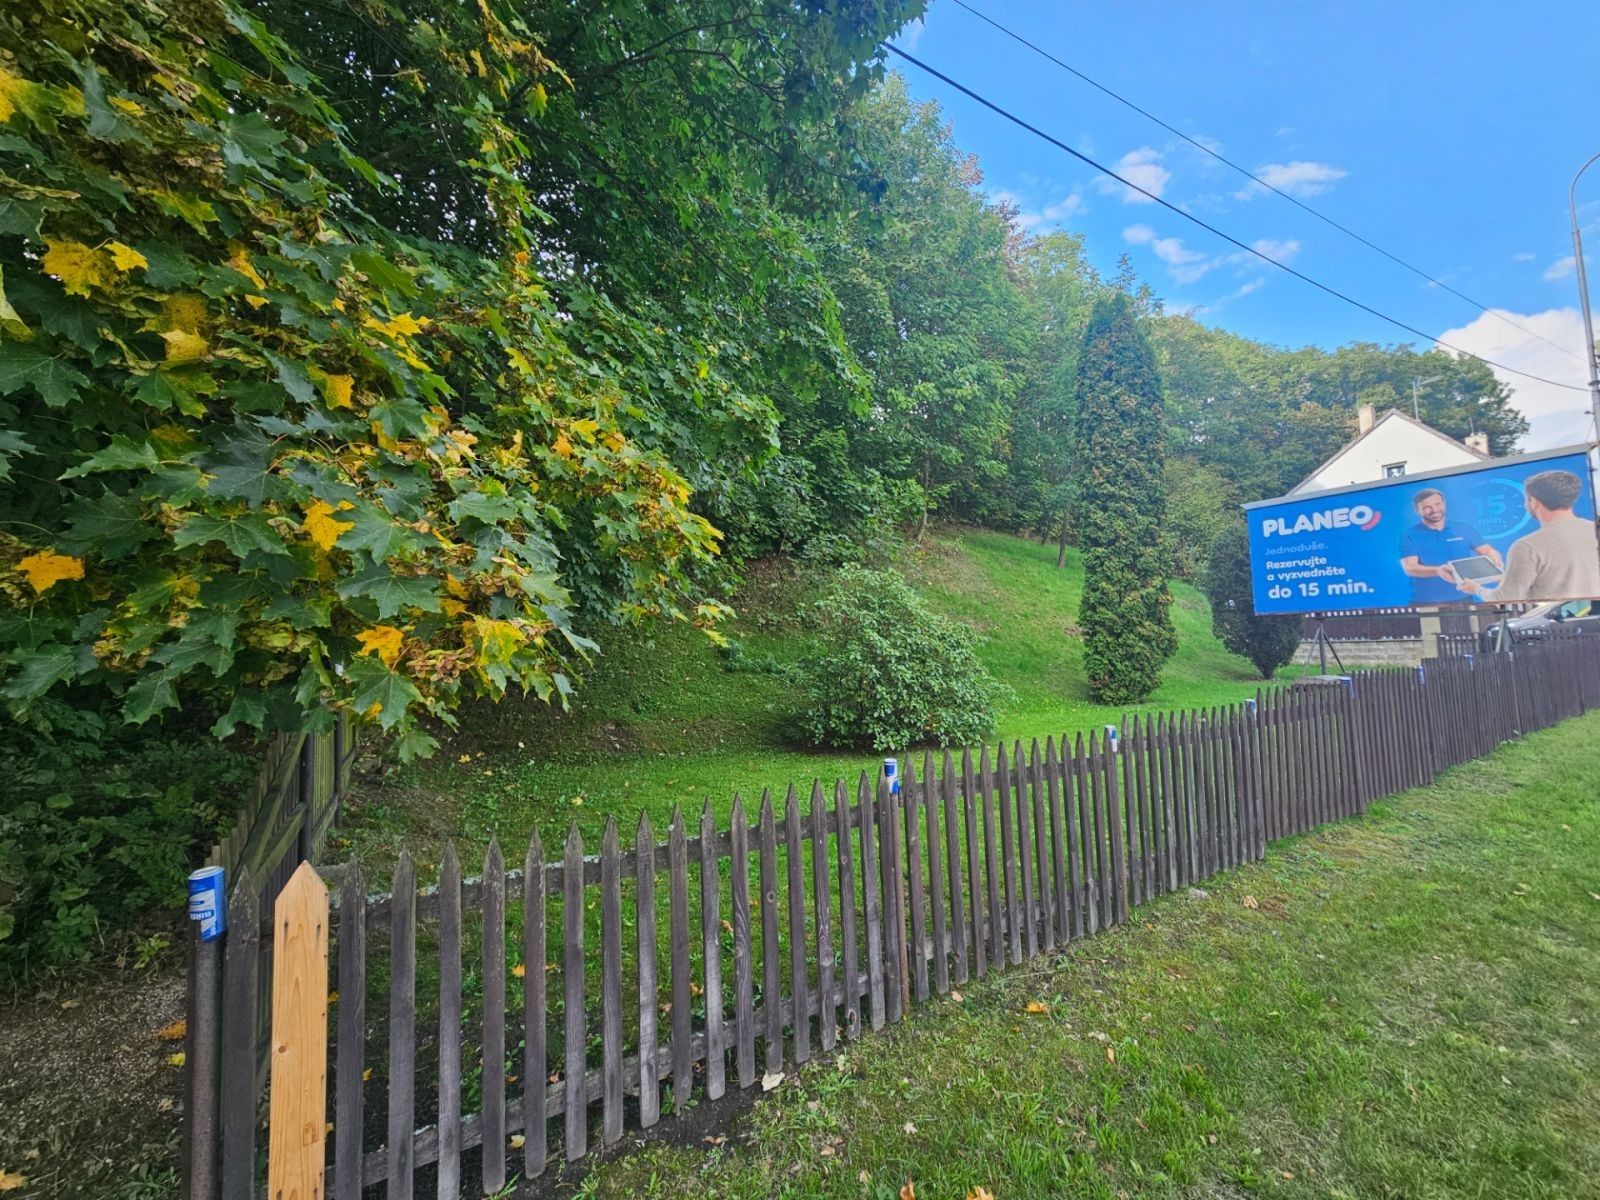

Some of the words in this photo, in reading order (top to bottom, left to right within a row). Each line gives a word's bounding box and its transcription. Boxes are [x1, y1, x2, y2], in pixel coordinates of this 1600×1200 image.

[1262, 505, 1374, 538] PLANEO
[1265, 541, 1329, 556] Jednoduše.
[1266, 556, 1328, 571] Rezervujte
[1267, 573, 1275, 581] a
[1278, 566, 1346, 582] vyzvedněte
[1268, 585, 1292, 599] do
[1299, 582, 1320, 598] 15
[1327, 579, 1375, 596] min.
